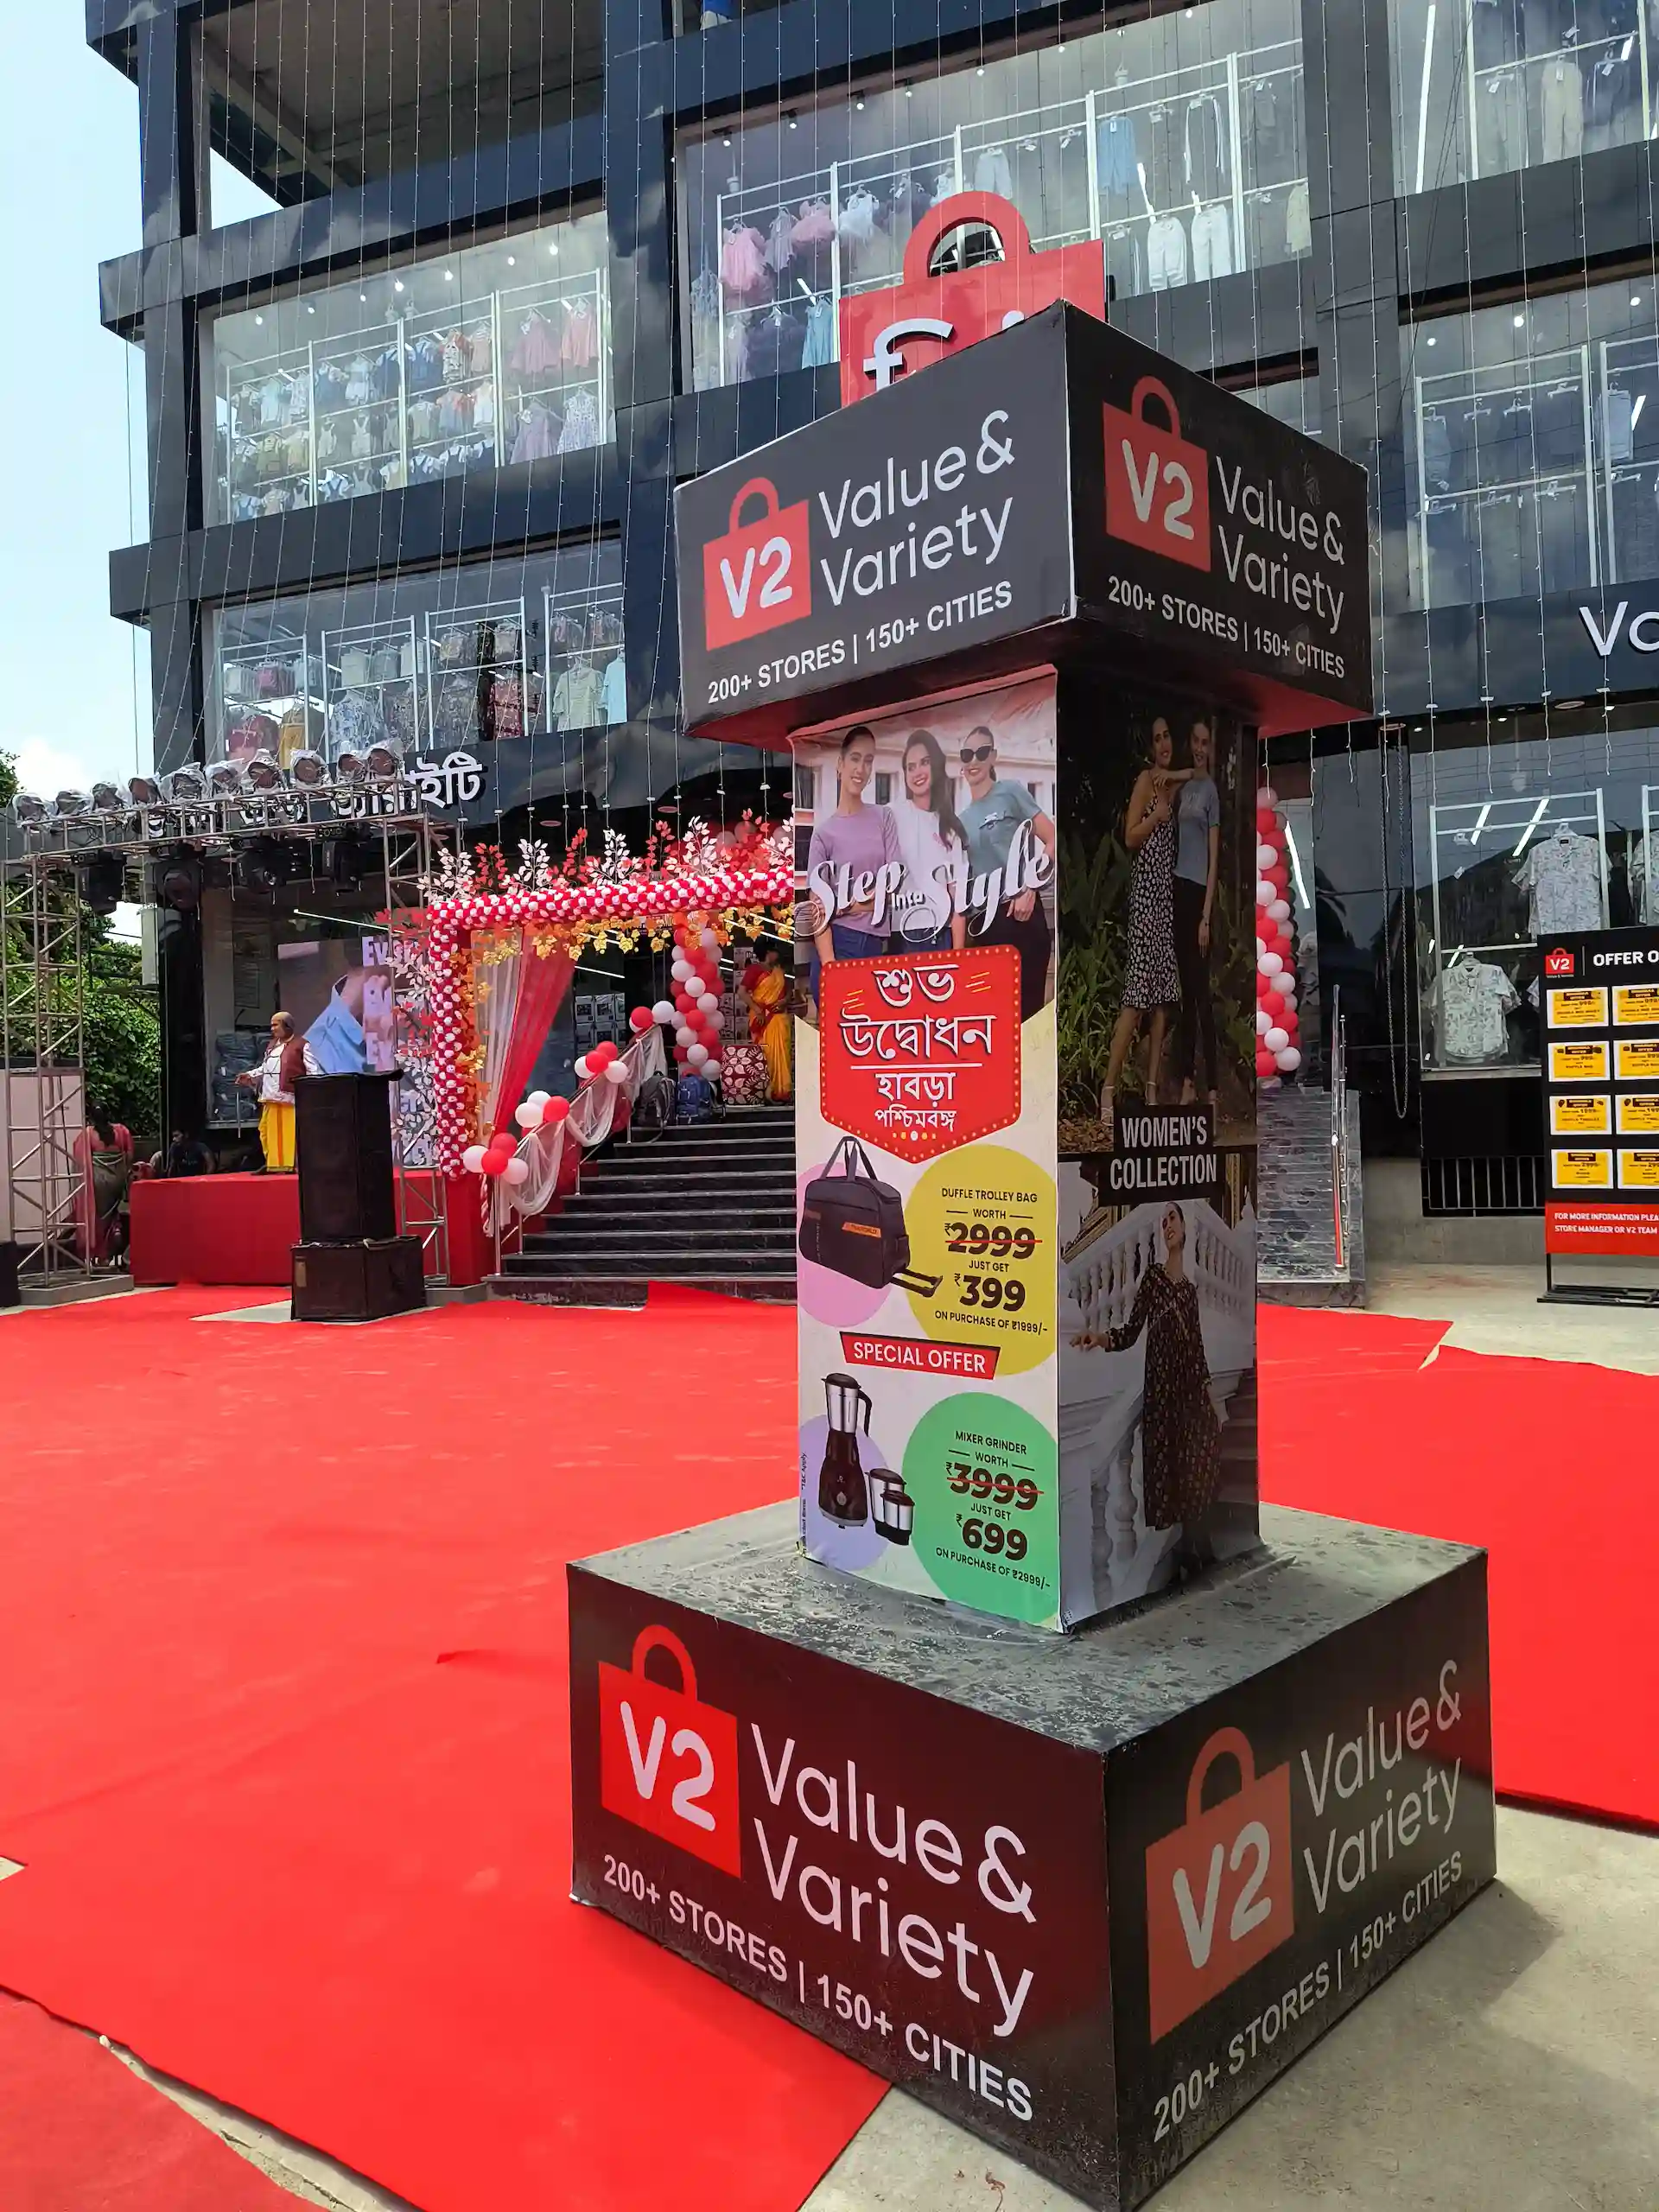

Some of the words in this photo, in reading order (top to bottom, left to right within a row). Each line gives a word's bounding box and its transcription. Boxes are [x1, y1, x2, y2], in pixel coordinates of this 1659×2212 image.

[818, 445, 963, 539] Value
[1121, 438, 1195, 540] V2
[1215, 456, 1319, 546] Value
[720, 536, 794, 619] V2
[820, 497, 1014, 607] Variety
[1217, 524, 1344, 634] Variety
[708, 673, 753, 704] 200+
[757, 639, 846, 688] STORES
[865, 616, 919, 654] 150+
[925, 581, 1013, 632] CITIES
[1107, 575, 1156, 612] 200+
[1161, 598, 1239, 642] STORES
[1253, 627, 1293, 663] 150+
[1294, 640, 1345, 680] CITIES
[793, 860, 907, 937] Step
[900, 818, 1055, 944] Style
[874, 964, 959, 1007] শুভ
[1549, 957, 1570, 970] V2
[1592, 951, 1643, 967] OFFER
[840, 1007, 997, 1060] উদ্বোধন
[875, 1071, 957, 1108] হাবড়া
[874, 1103, 957, 1131] পশ্চিমবঙ্গ
[1122, 1116, 1207, 1148] WOMEN'S
[942, 1187, 973, 1199] DUFFLE
[975, 1190, 1014, 1201] TROLLEY
[1016, 1192, 1038, 1203] BAG
[1109, 1154, 1217, 1190] COLLECTION
[973, 1208, 1007, 1219] WORTH
[1578, 1225, 1614, 1234] MANAGER
[969, 1260, 991, 1270] JUST
[993, 1262, 1009, 1273] GET
[935, 1310, 948, 1319] ON
[950, 1312, 995, 1327] PURCHASE
[998, 1319, 1009, 1329] OF
[853, 1342, 924, 1366] SPECIAL
[928, 1350, 986, 1374] OFFER
[956, 1431, 983, 1446] MIXER
[985, 1434, 1027, 1454] GRINDER
[975, 1452, 1008, 1467] WORTH
[971, 1503, 993, 1517] JUST
[994, 1508, 1012, 1521] GET
[936, 1548, 949, 1558] ON
[950, 1551, 996, 1573] PURCHASE
[998, 1565, 1010, 1576] OF
[620, 1700, 715, 1833] V2
[1300, 1696, 1432, 1818] Value
[751, 1722, 963, 1884] Value
[1302, 1757, 1462, 1915] Variety
[1172, 1821, 1273, 1970] V2
[753, 1817, 1035, 2038] Variety
[604, 1854, 661, 1906] 200+
[669, 1890, 787, 1984] STORES
[817, 1974, 894, 2037] 150+
[905, 2022, 1034, 2123] CITIES
[1153, 2061, 1220, 2144] 200+
[1228, 1960, 1331, 2076] STORES
[1349, 1910, 1397, 1970] 150+
[1401, 1851, 1463, 1924] CITIES
